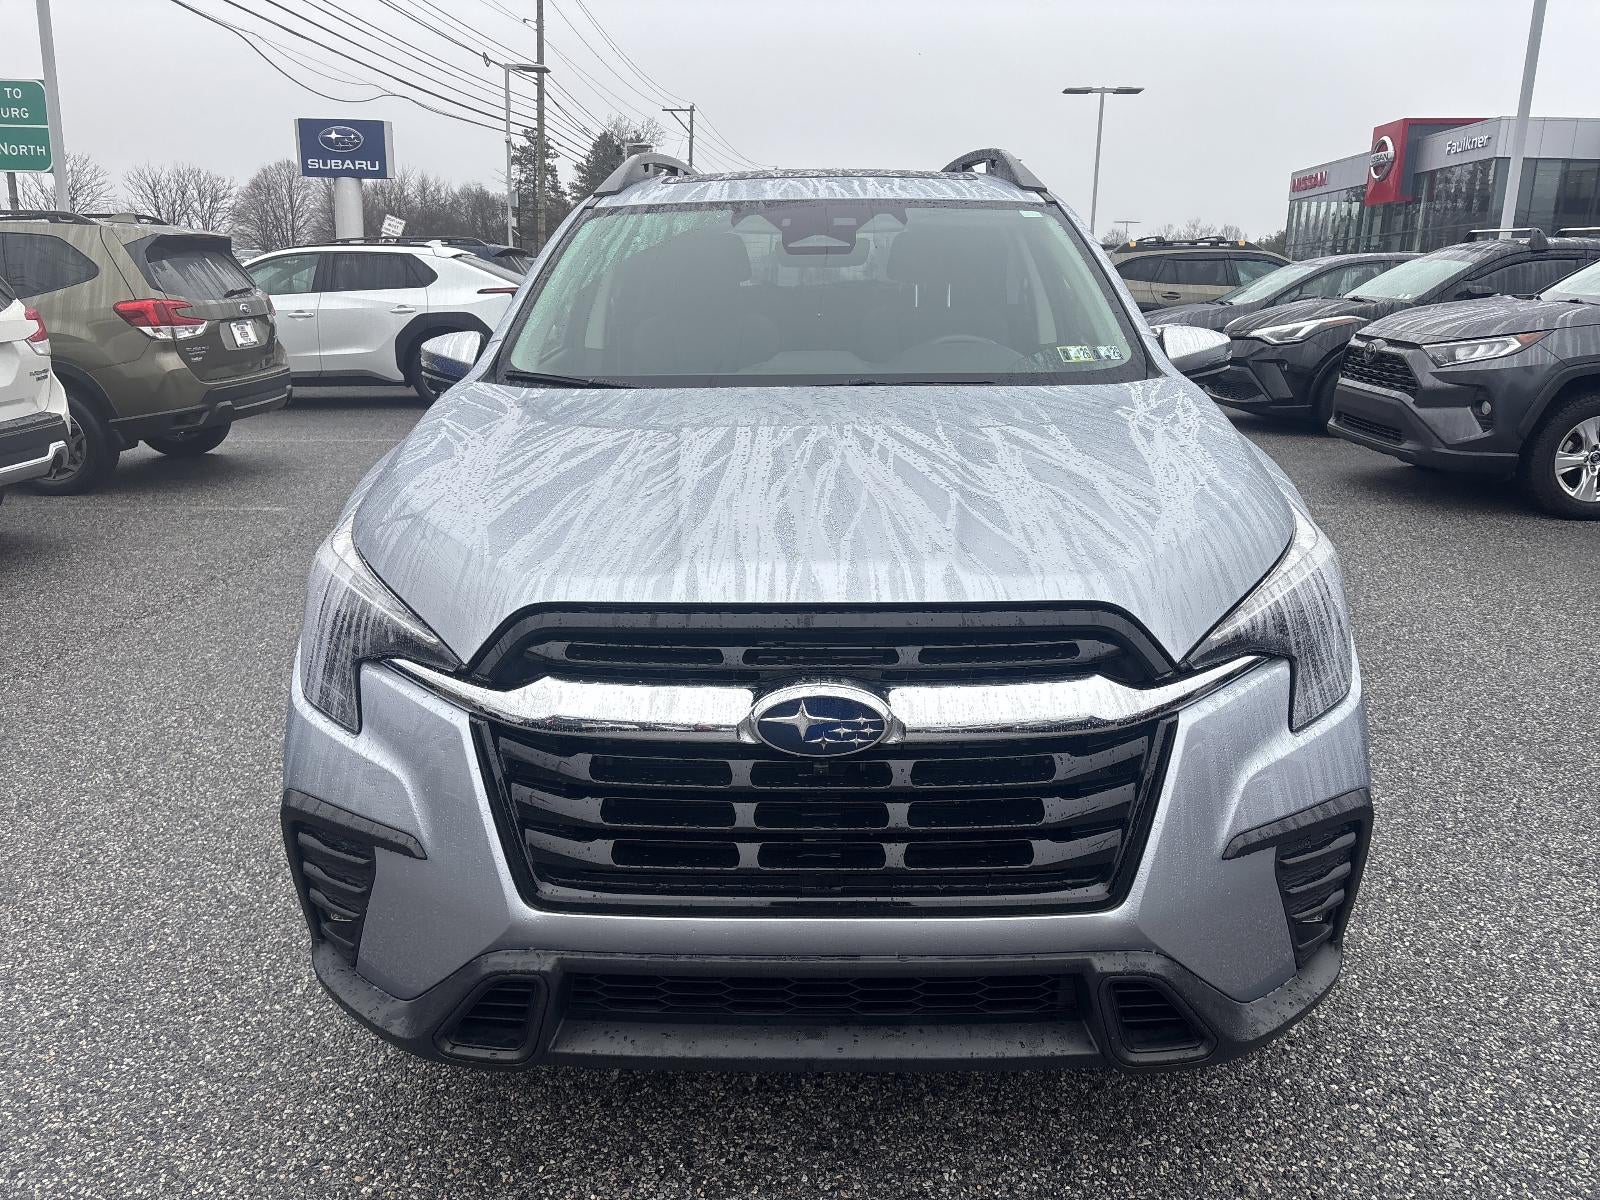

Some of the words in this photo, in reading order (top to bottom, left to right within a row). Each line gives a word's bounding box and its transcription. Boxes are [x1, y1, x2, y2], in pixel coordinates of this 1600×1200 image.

[4, 87, 22, 99] TO
[0, 107, 29, 119] URG
[1445, 134, 1490, 155] Faulkner
[307, 158, 380, 171] SUBARU
[1291, 170, 1328, 193] NISSAN
